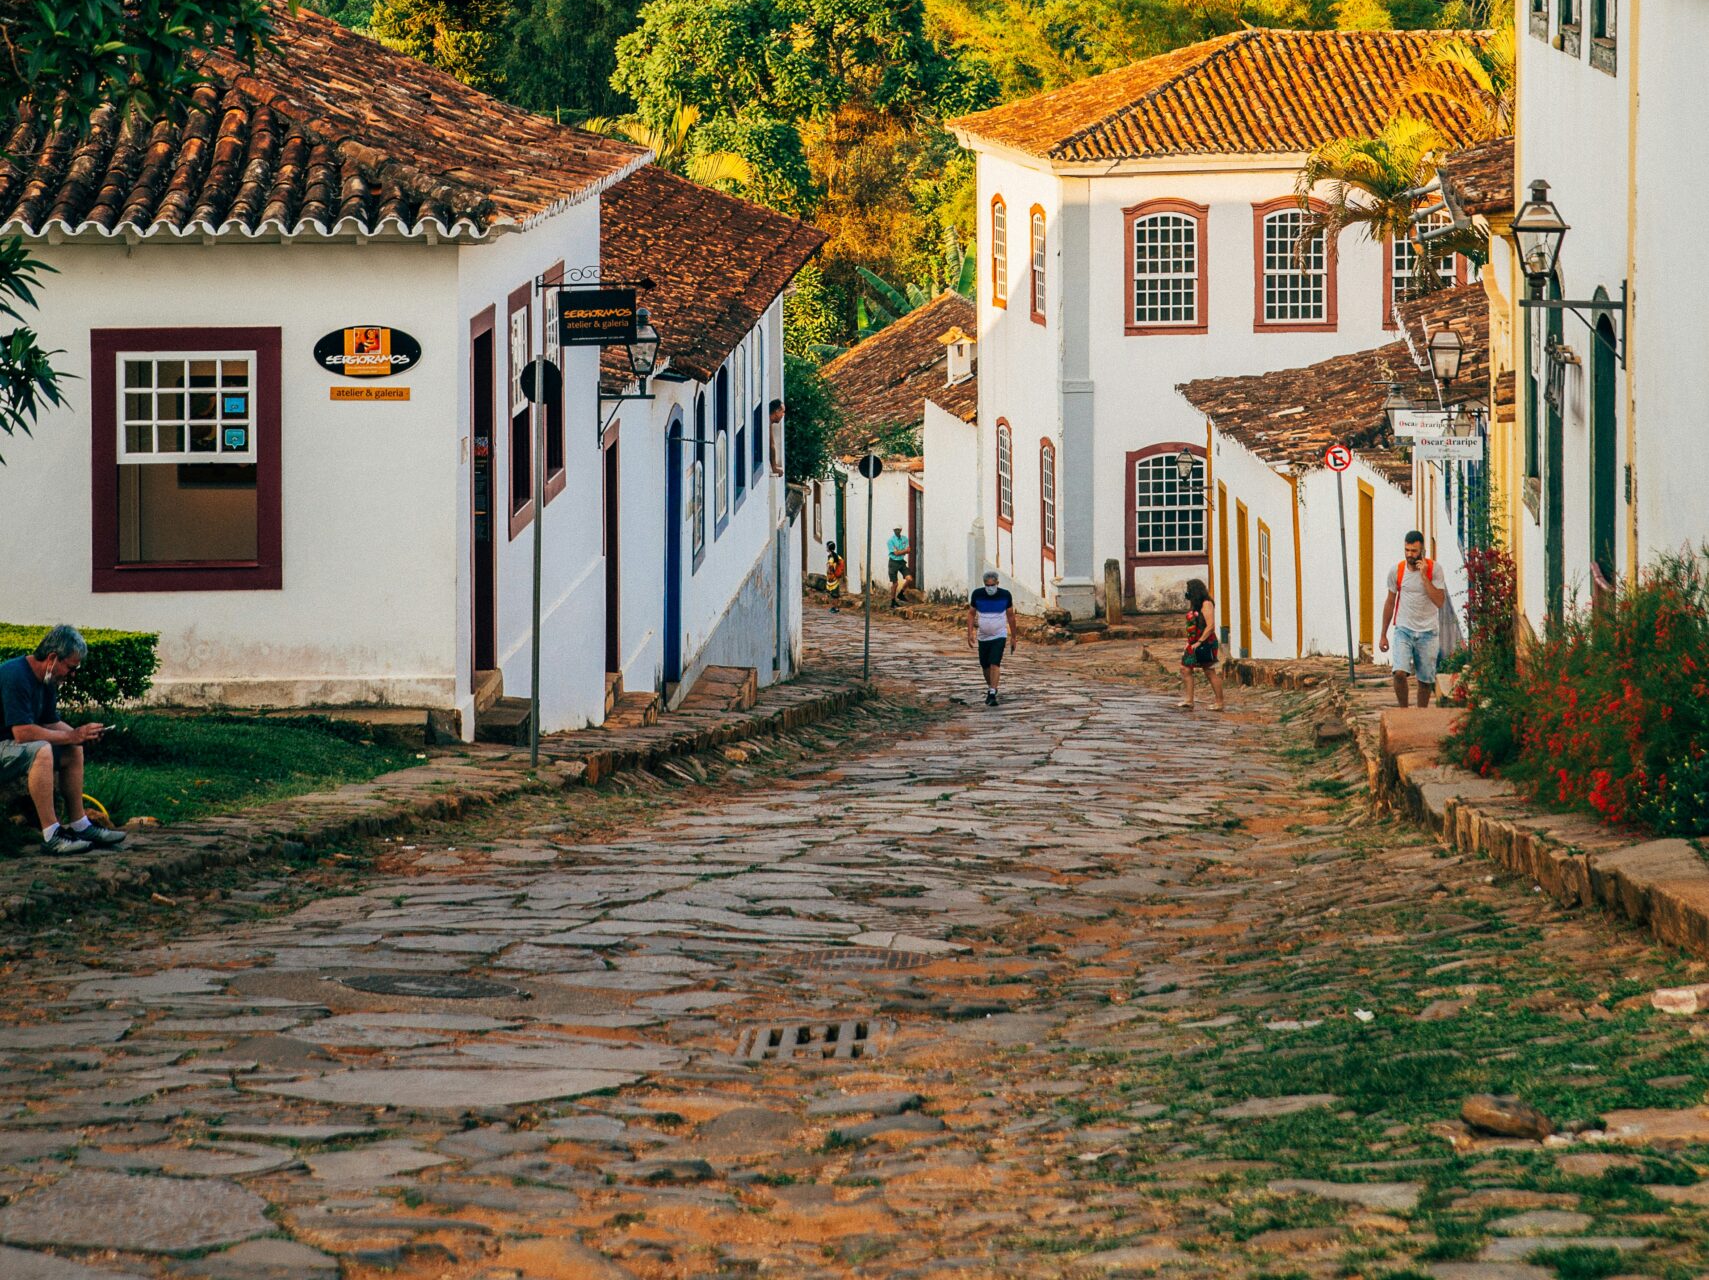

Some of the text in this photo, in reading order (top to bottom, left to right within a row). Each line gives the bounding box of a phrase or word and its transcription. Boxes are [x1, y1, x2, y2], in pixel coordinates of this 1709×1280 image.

[564, 308, 632, 318] SERGIORAMOS
[567, 319, 629, 329] atelier & galeria
[325, 354, 410, 365] SERGIORAMOS
[336, 389, 404, 400] atelier & galeria
[1332, 450, 1345, 467] E
